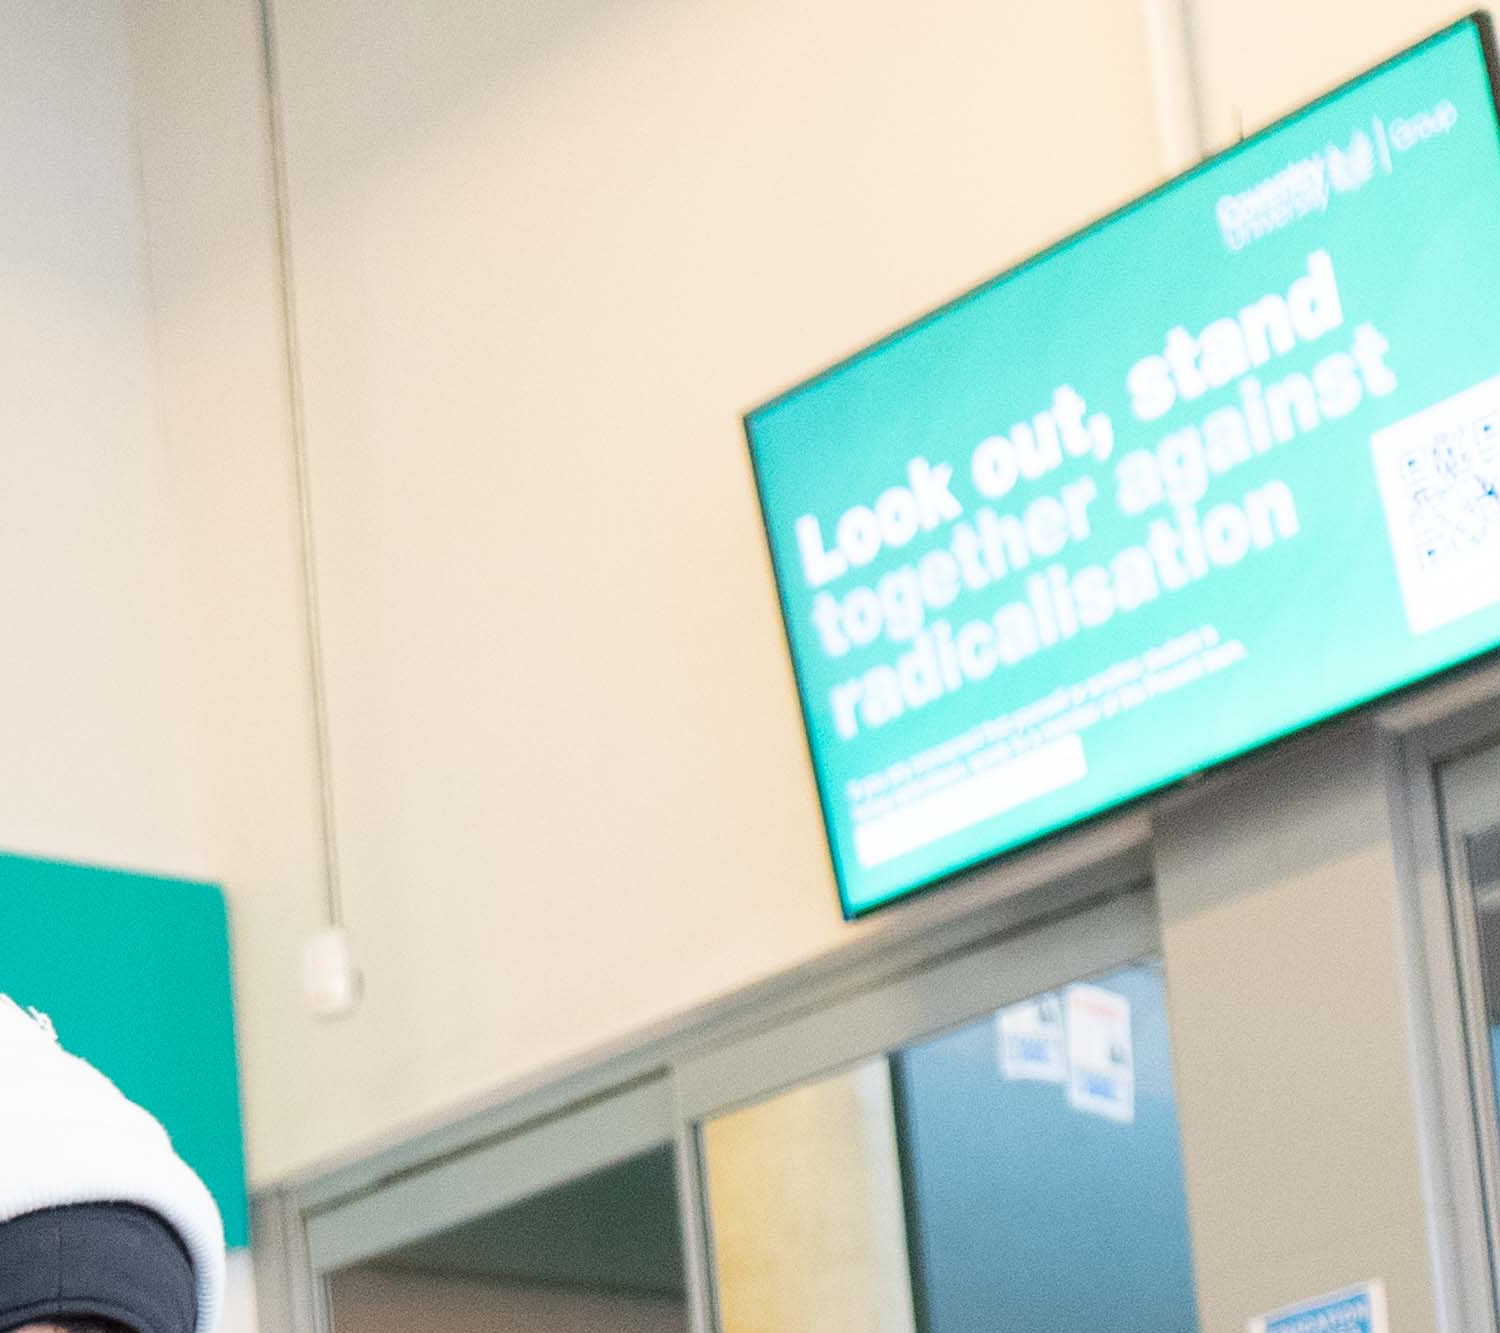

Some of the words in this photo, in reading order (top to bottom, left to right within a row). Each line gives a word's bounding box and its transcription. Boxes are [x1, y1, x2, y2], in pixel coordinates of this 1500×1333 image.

[796, 457, 962, 587] Look
[971, 384, 1114, 500] out,
[1127, 250, 1343, 418] stand
[813, 476, 1097, 656] together
[1114, 322, 1397, 516] against
[829, 478, 1300, 740] radicalisation
